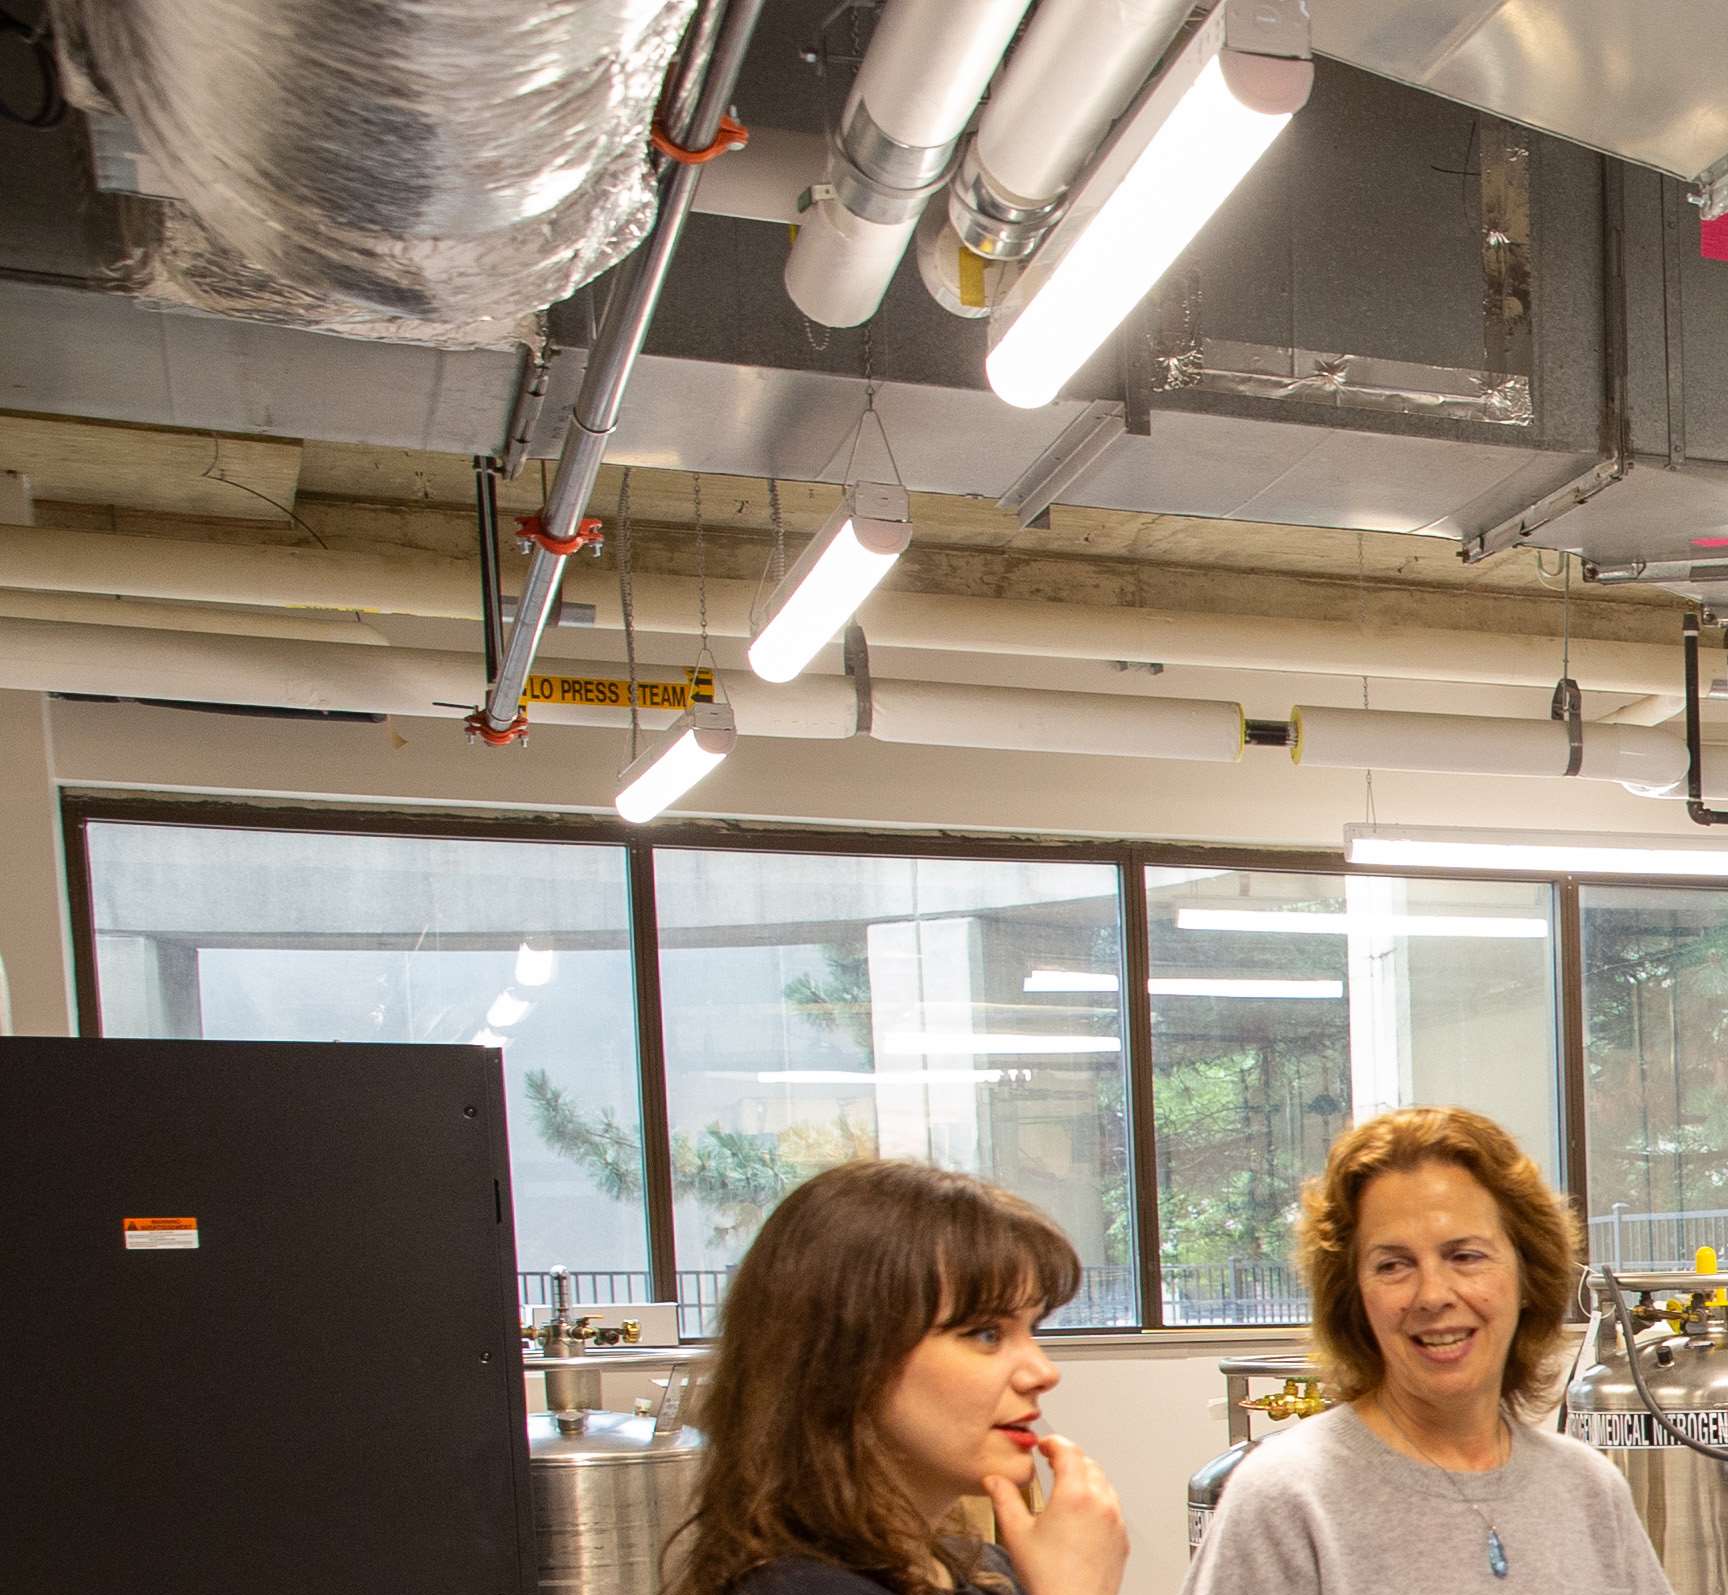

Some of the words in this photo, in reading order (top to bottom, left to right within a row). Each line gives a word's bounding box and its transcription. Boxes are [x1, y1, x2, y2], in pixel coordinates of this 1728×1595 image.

[530, 678, 553, 700] LO
[561, 680, 620, 703] PRESS
[1597, 1414, 1650, 1447] MEDICAL
